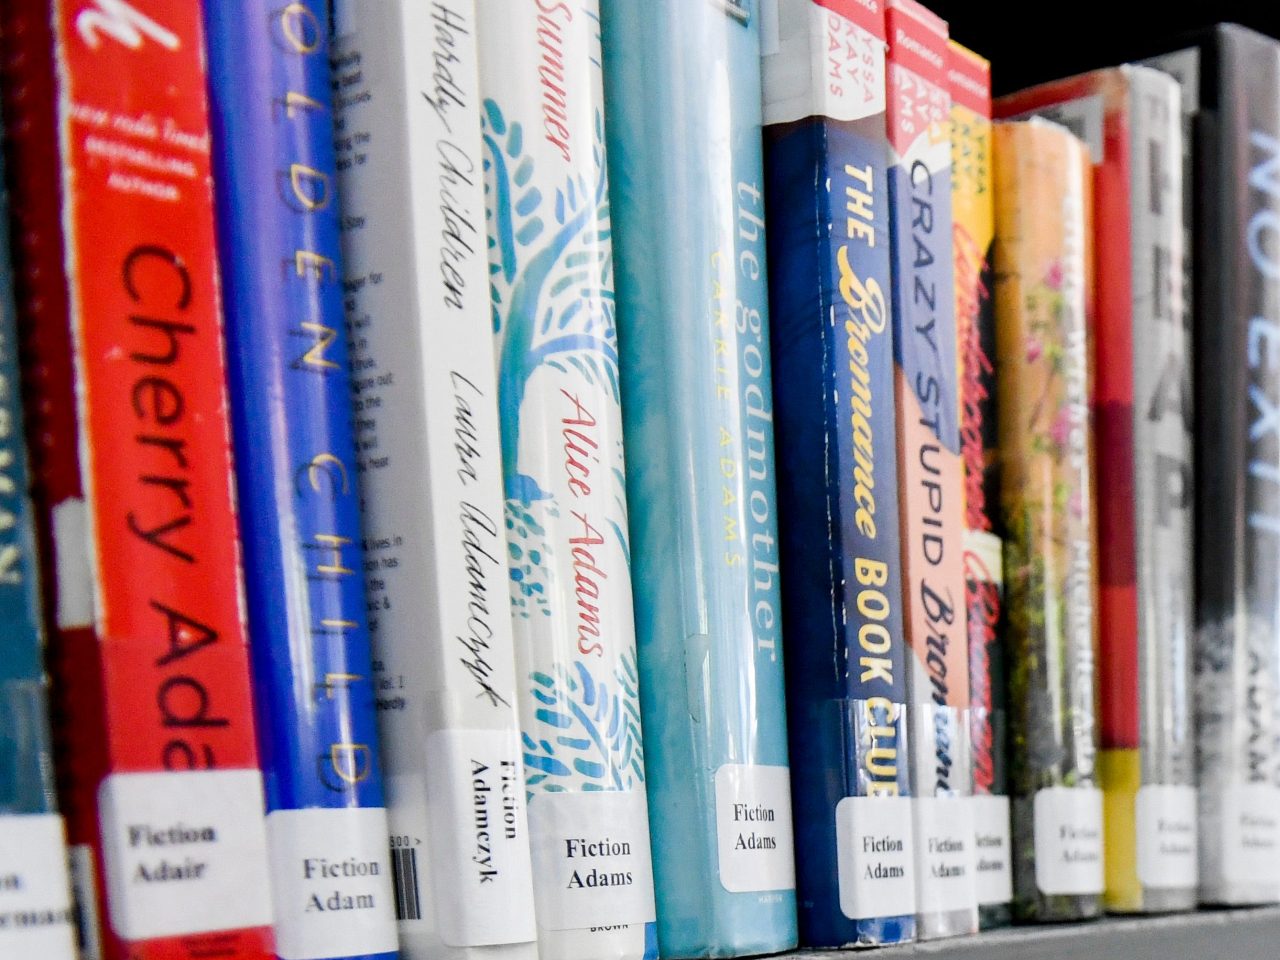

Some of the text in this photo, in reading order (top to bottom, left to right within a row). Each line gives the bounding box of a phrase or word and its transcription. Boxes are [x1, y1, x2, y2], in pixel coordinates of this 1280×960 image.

[534, 0, 573, 162] Summer
[421, 2, 476, 309] Hardy Children
[845, 164, 875, 247] THE
[910, 160, 939, 351] CRAZY
[121, 244, 197, 564] Cherry
[451, 370, 484, 486] Laura
[735, 180, 779, 662] the godmother
[836, 246, 886, 540] Bromance
[719, 426, 742, 567] ADAMS
[915, 374, 944, 566] STUPID
[560, 388, 608, 658] Alice Adams
[308, 452, 371, 784] CHILD
[855, 558, 893, 685] BOOK
[129, 824, 216, 848] Fiction
[470, 758, 498, 884] Adamczyk
[500, 760, 519, 840] Fiction
[734, 803, 775, 823] Fiction
[735, 832, 777, 851] Adams
[134, 861, 207, 883] Adair
[304, 856, 380, 880] Fiction
[565, 838, 631, 859] Fiction
[567, 869, 633, 890] Adams
[863, 835, 903, 853] Fiction
[864, 862, 904, 880] Adams
[928, 837, 964, 853] Fiction
[931, 863, 966, 880] Adams
[305, 889, 376, 912] Adam
